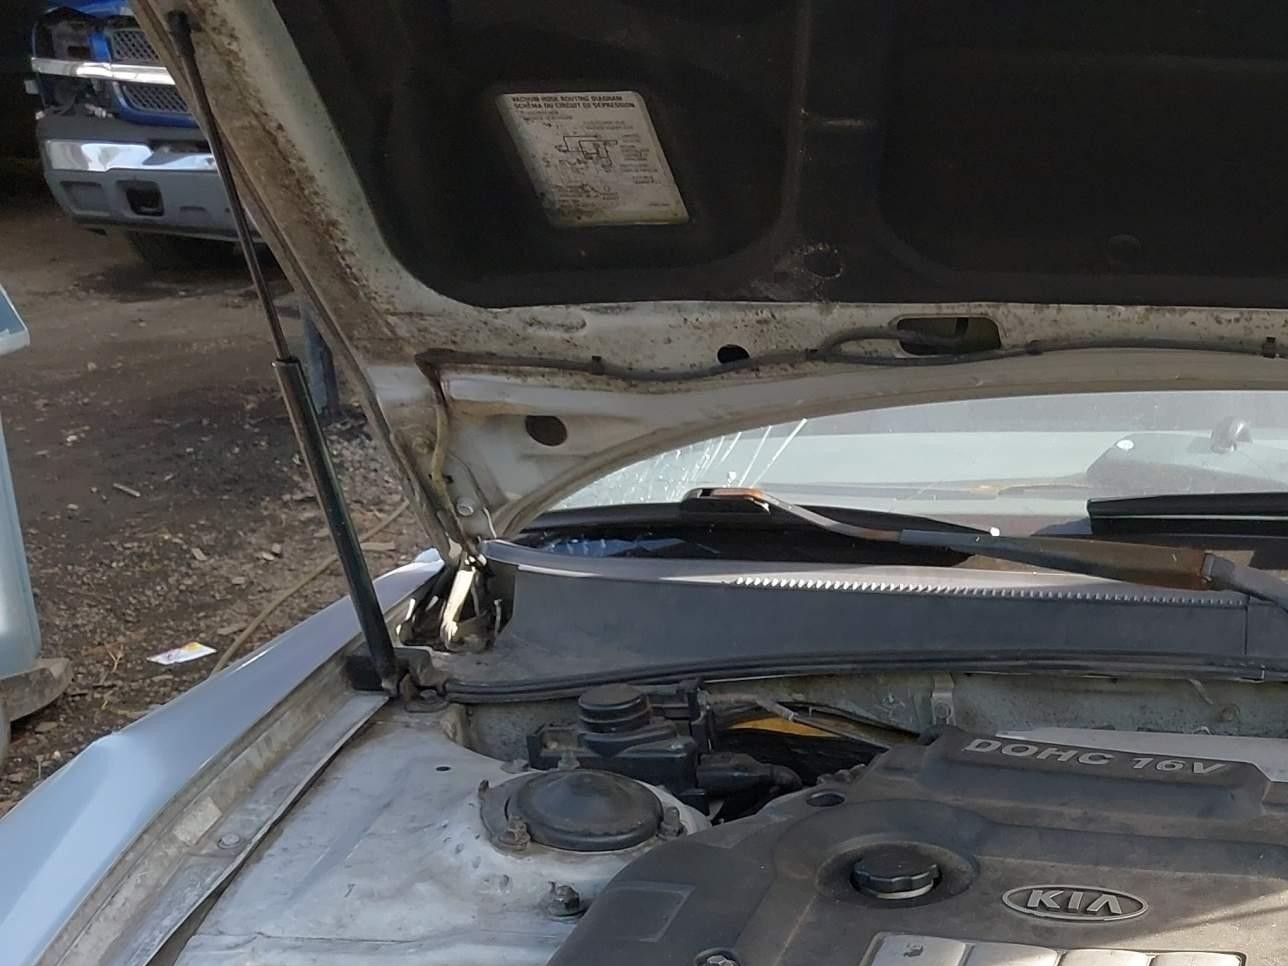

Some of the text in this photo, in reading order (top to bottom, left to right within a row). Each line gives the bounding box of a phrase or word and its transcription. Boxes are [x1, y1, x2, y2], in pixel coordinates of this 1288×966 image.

[963, 738, 1227, 775] DOHC 16V
[1026, 889, 1123, 915] KIA
